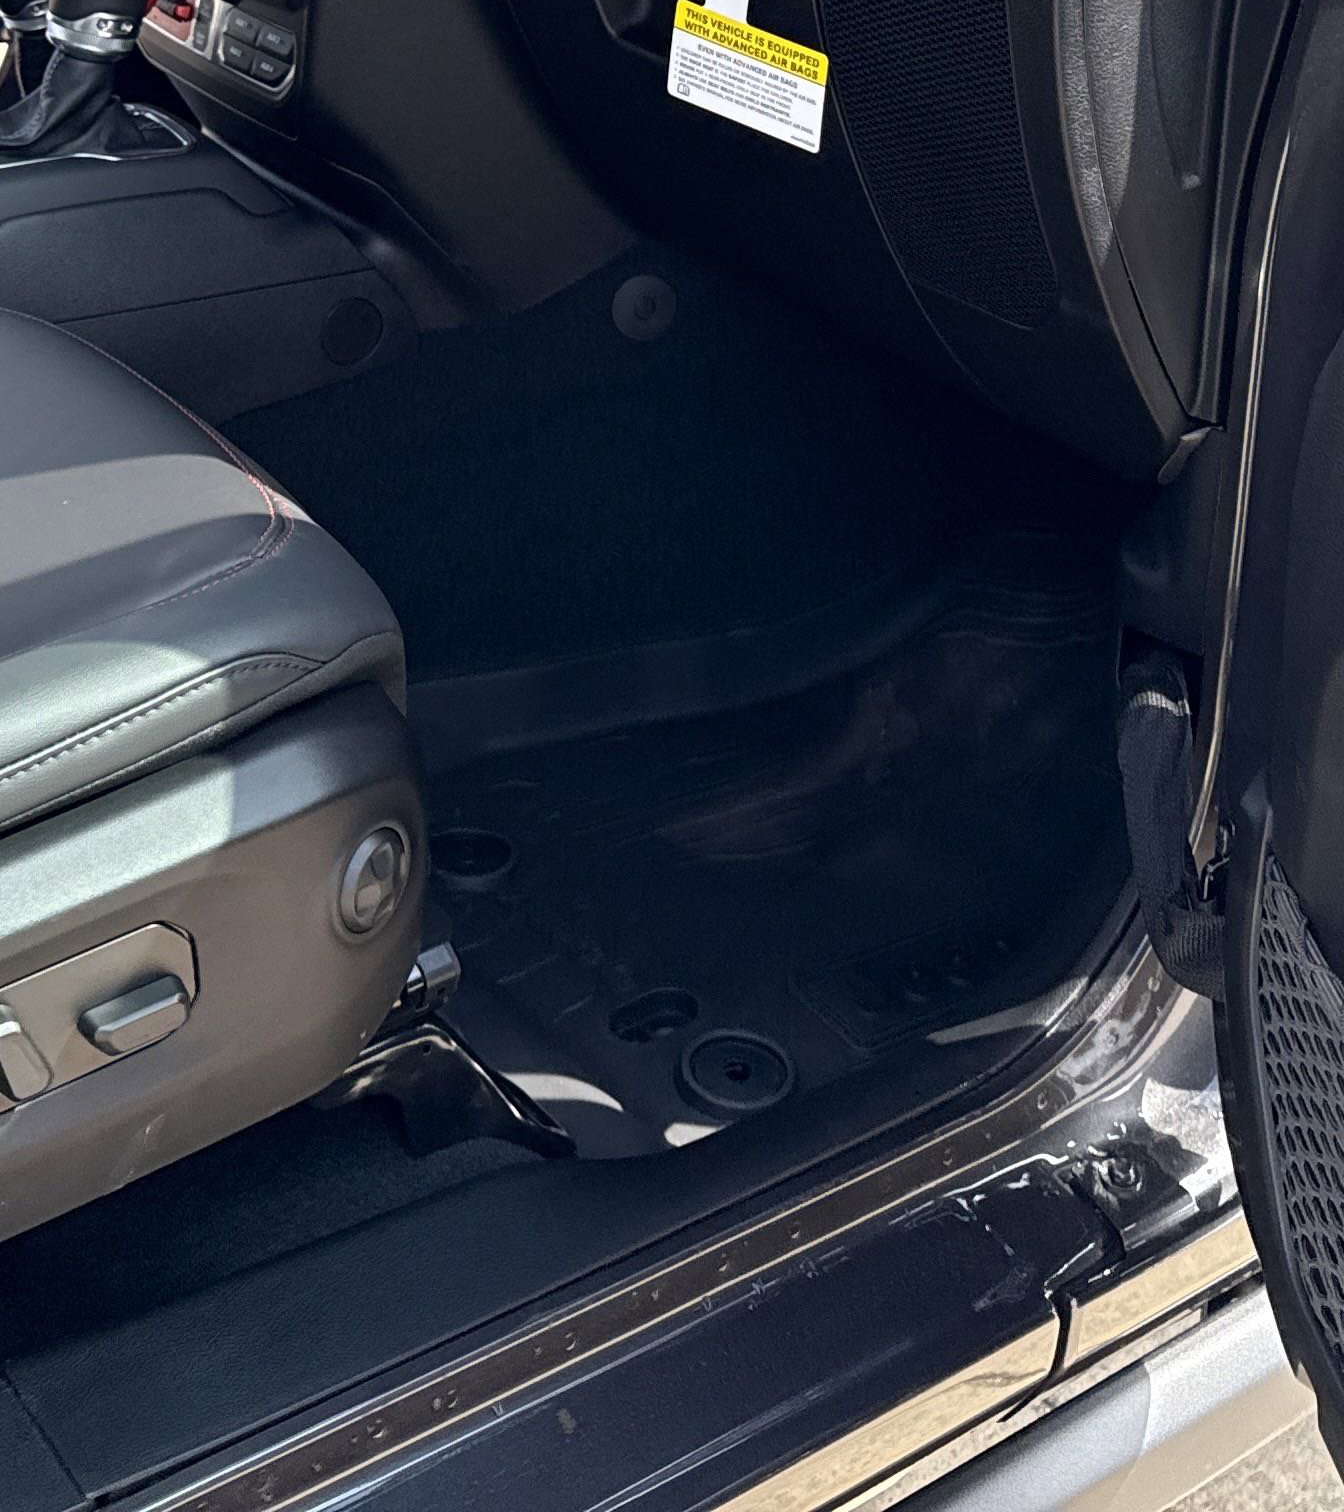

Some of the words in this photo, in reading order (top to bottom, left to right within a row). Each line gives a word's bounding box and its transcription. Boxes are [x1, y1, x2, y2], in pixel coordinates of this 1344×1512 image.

[684, 20, 710, 38] WITH
[712, 30, 768, 61] ADVANCED
[770, 53, 788, 68] AIR
[790, 60, 819, 81] BAGS
[685, 7, 709, 25] THIS
[710, 16, 753, 43] VEHICLE
[755, 35, 765, 48] IS
[767, 41, 820, 69] EQUIPPED
[715, 49, 733, 64] WITH
[733, 56, 768, 77] ADVANCED
[768, 69, 780, 82] AIR
[780, 74, 798, 90] BAGS
